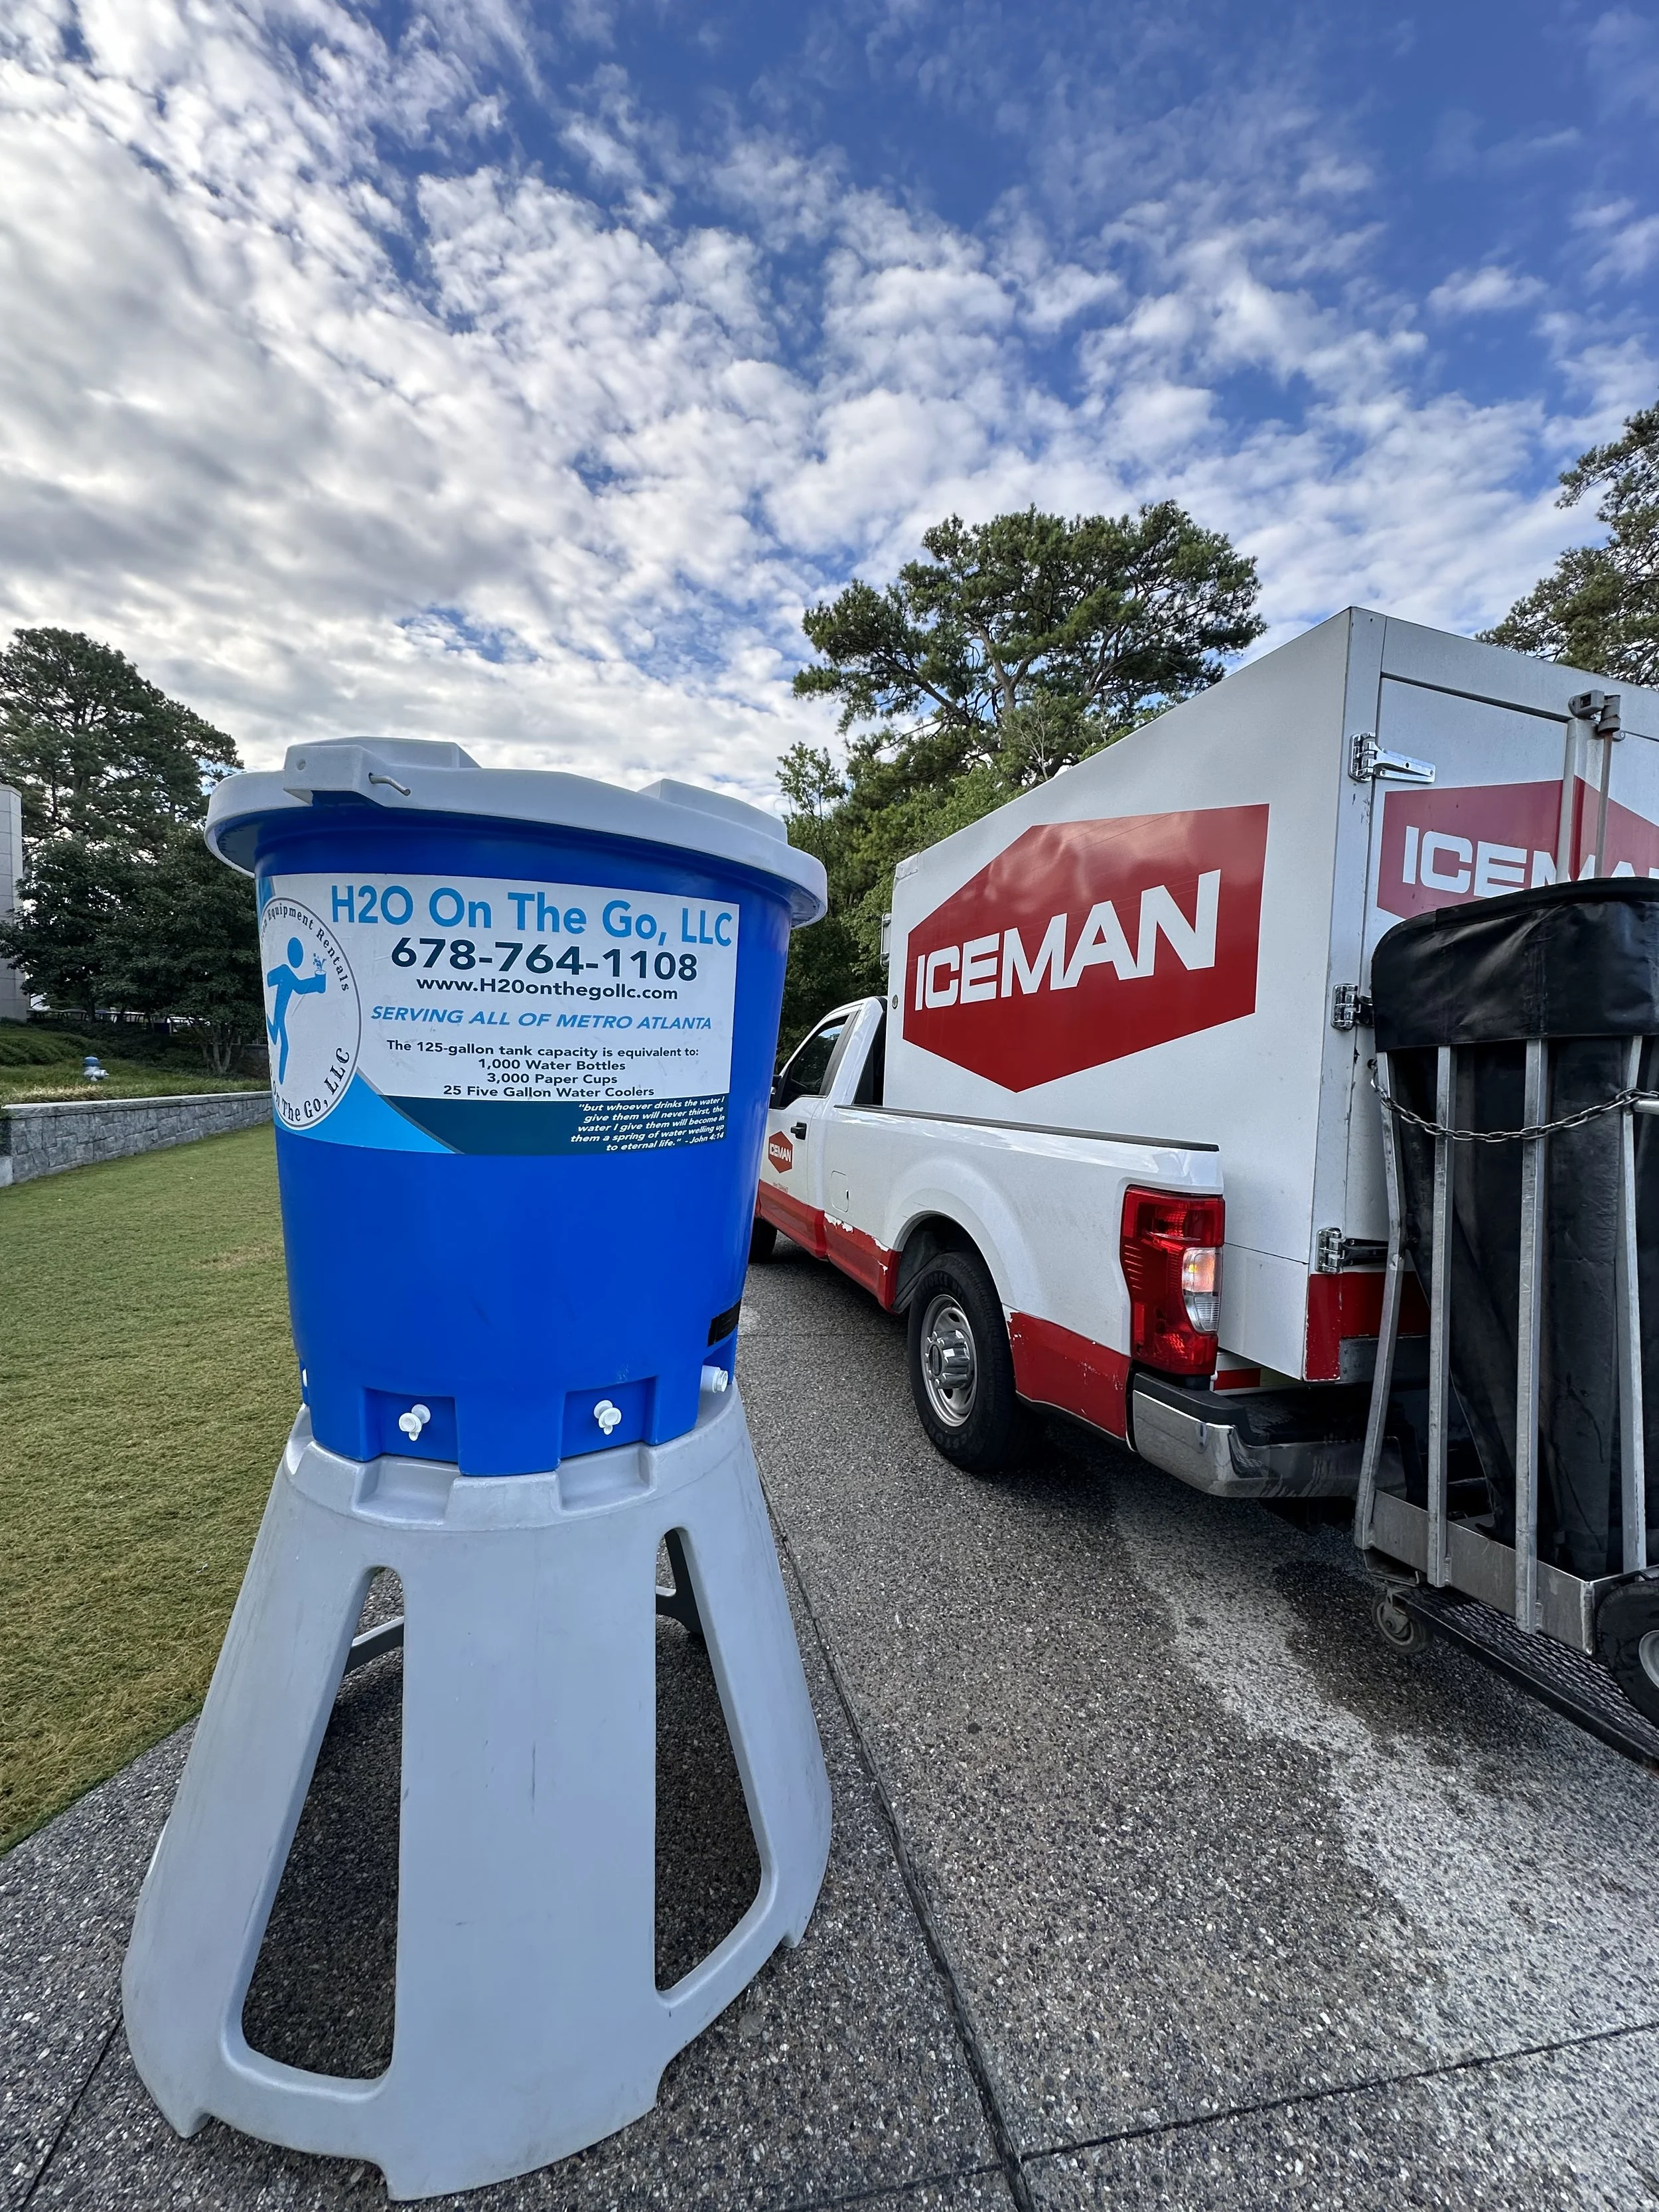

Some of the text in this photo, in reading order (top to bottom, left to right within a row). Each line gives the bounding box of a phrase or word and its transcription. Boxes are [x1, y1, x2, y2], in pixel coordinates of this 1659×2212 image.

[332, 885, 732, 947] H2O On The Go, LLC
[267, 903, 349, 992] Equipment Rentals
[914, 869, 1221, 1011] ICEMAN
[392, 937, 697, 981] 678-764-1108
[371, 1005, 711, 1029] SERVING ALL OF METRO ATLANTA
[387, 1040, 411, 1051] The
[417, 1041, 494, 1056] 125-gallon
[499, 1045, 532, 1055] tank
[538, 1047, 598, 1059] capacity
[603, 1047, 613, 1057] is
[617, 1047, 682, 1059] equivalent
[478, 1059, 626, 1070] 1,000 Water Bottles
[281, 1098, 301, 1122] The
[324, 1047, 350, 1095] LLC
[487, 1072, 618, 1086] 3,000 Paper Cups
[443, 1085, 654, 1097] 25 Five Gallon Water Coolers
[654, 1100, 682, 1109] drinks
[583, 1114, 609, 1124] give
[642, 1111, 659, 1120] will
[689, 1108, 710, 1116] thirst,
[620, 1122, 643, 1132] give
[689, 1117, 717, 1126] become
[612, 1132, 646, 1143] spring
[688, 1125, 715, 1135] welling
[715, 1124, 725, 1132] up
[620, 1141, 656, 1150] eternal
[689, 1136, 708, 1144] John
[709, 1132, 724, 1140] 4:14
[769, 1143, 792, 1163] ICEMAN
